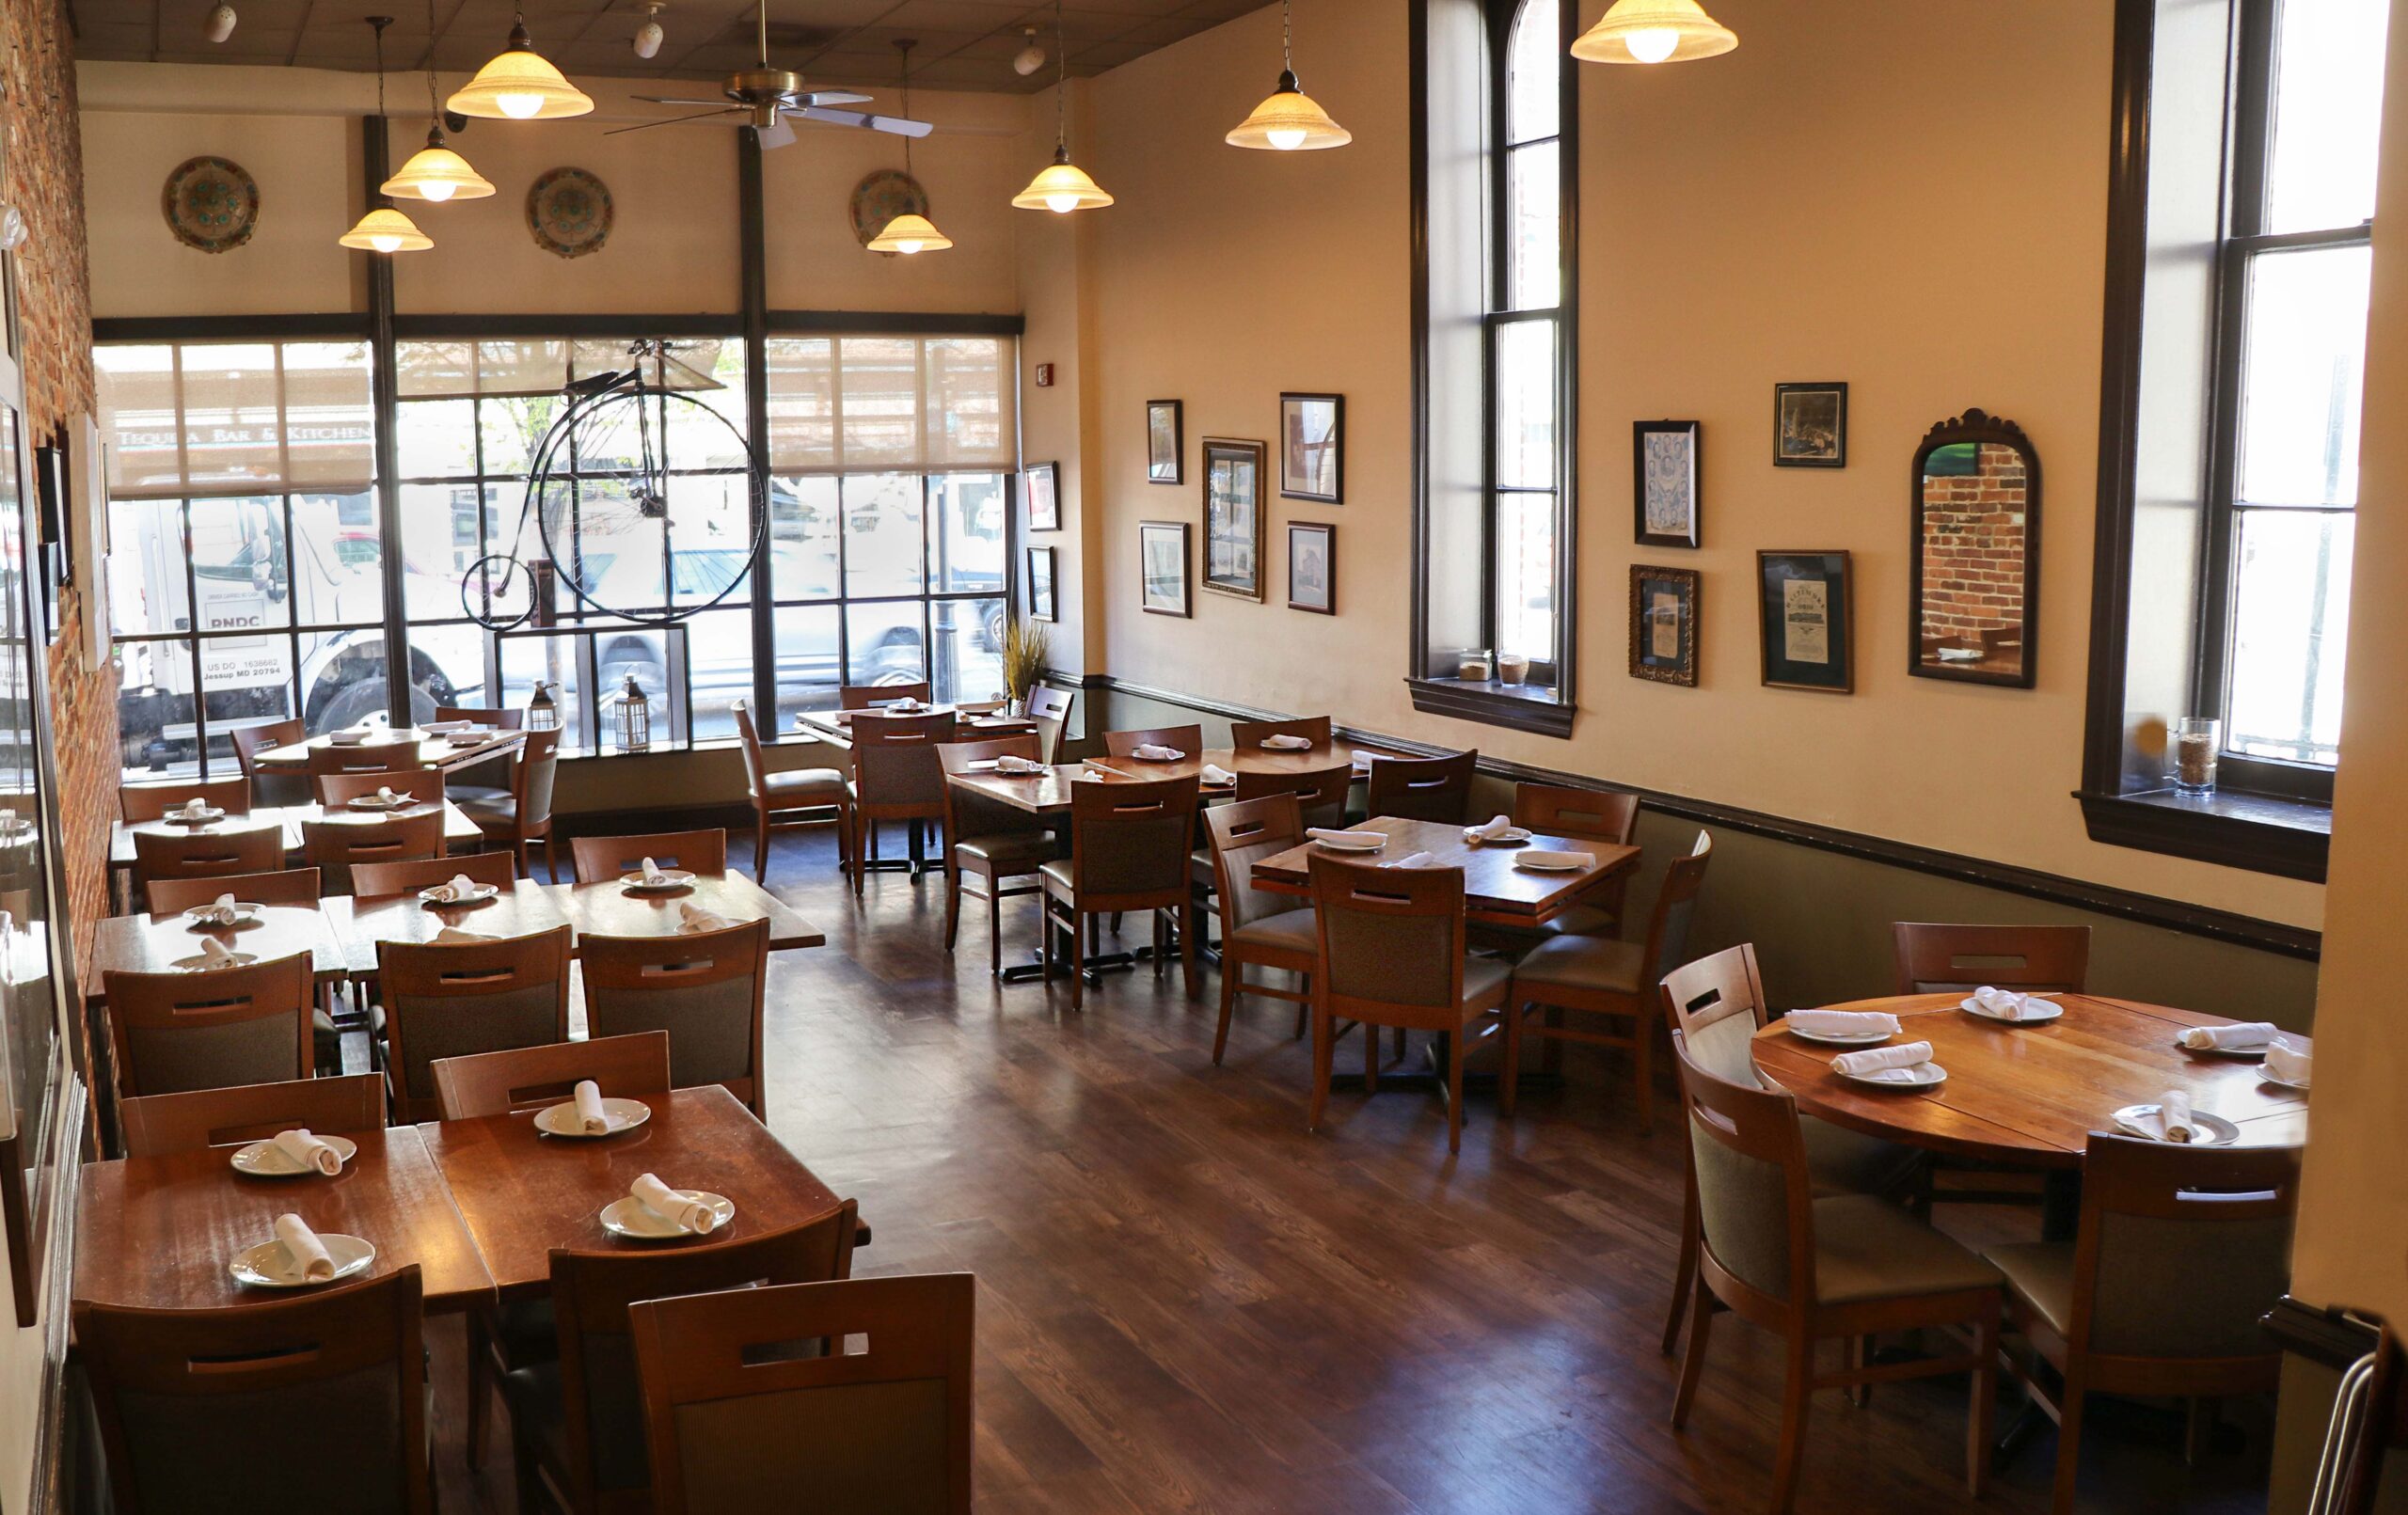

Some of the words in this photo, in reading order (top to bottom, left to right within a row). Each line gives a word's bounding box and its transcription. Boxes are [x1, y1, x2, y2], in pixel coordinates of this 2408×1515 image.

[116, 431, 200, 445] TEQUIA
[214, 429, 250, 442] BAR
[261, 427, 276, 441] &
[287, 426, 371, 440] KITCHEN
[207, 662, 220, 671] US
[253, 667, 280, 676] 20794
